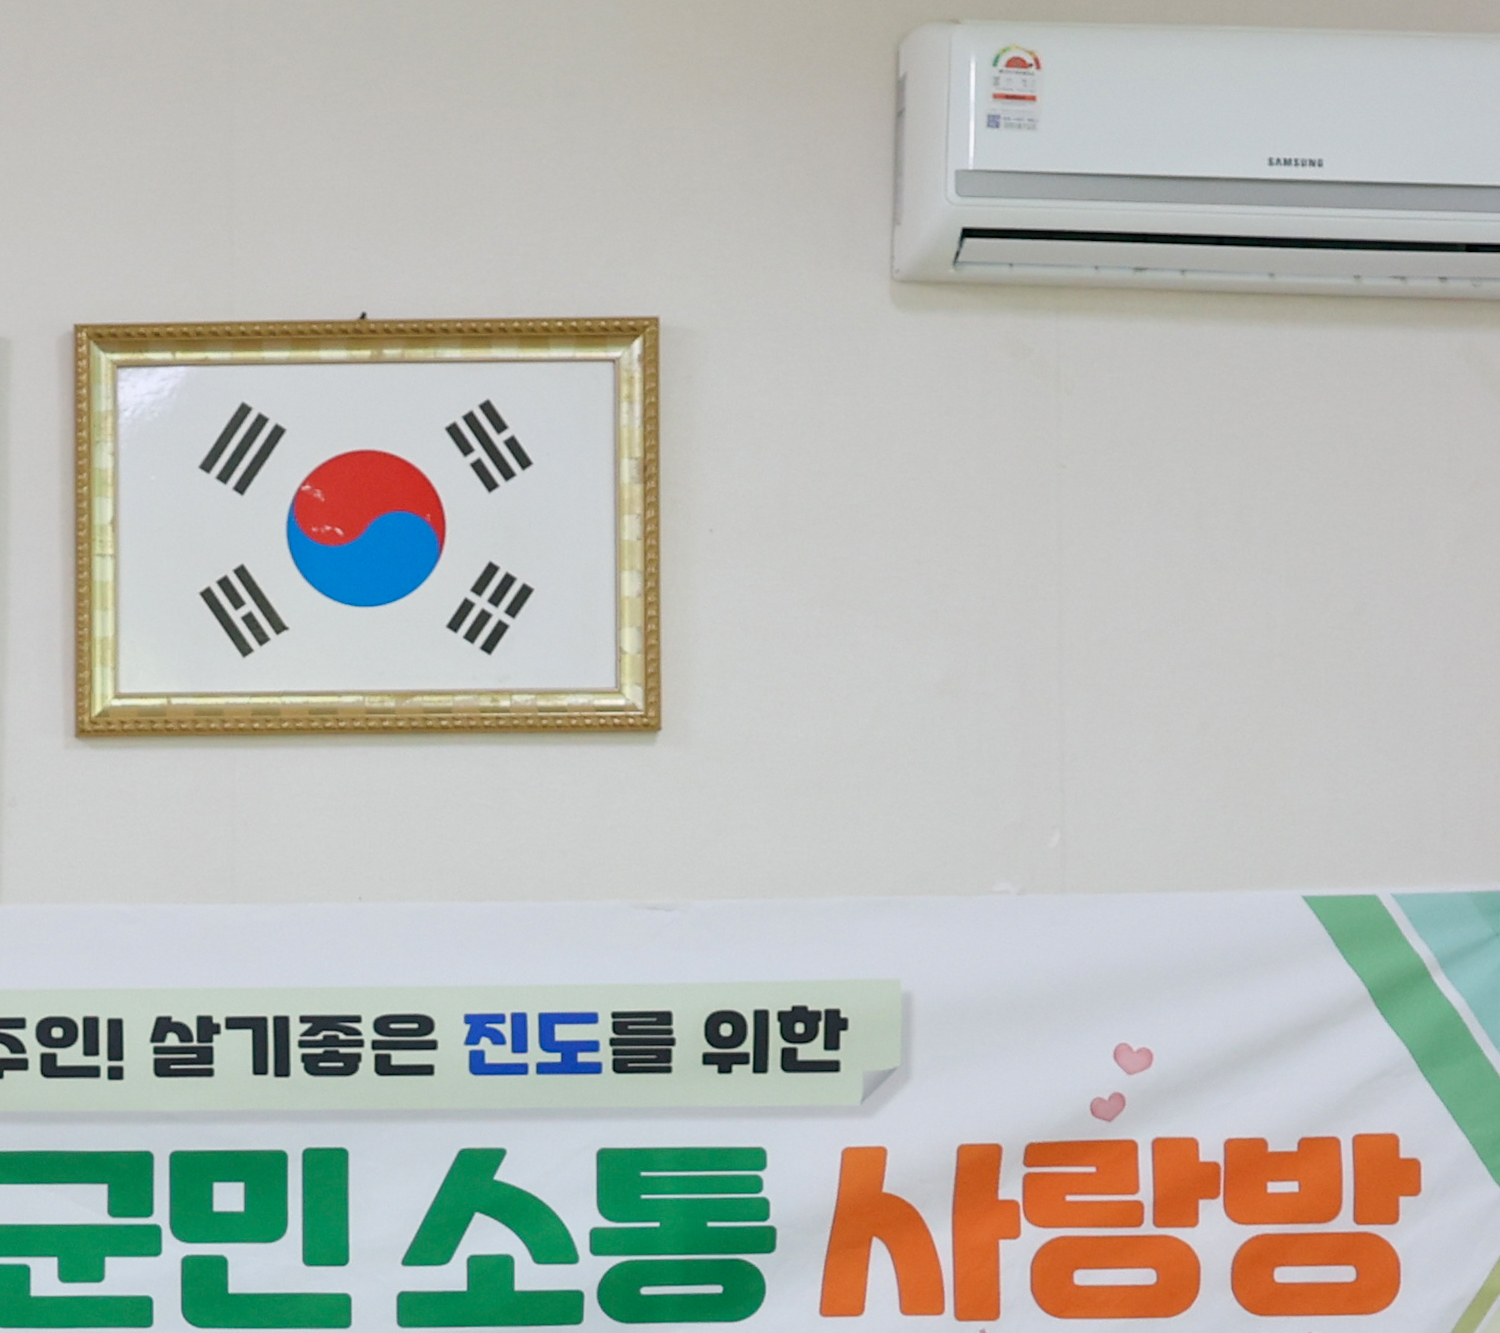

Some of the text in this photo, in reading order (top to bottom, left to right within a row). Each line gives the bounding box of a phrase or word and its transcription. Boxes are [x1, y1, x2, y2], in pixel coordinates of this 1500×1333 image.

[1267, 157, 1324, 168] SAMSUNG
[150, 1013, 438, 1078] 살기좋은
[464, 1010, 676, 1076] 진도를
[702, 1007, 850, 1075] 위한
[396, 1147, 776, 1328] 소통
[820, 1133, 1422, 1322] 사랑방
